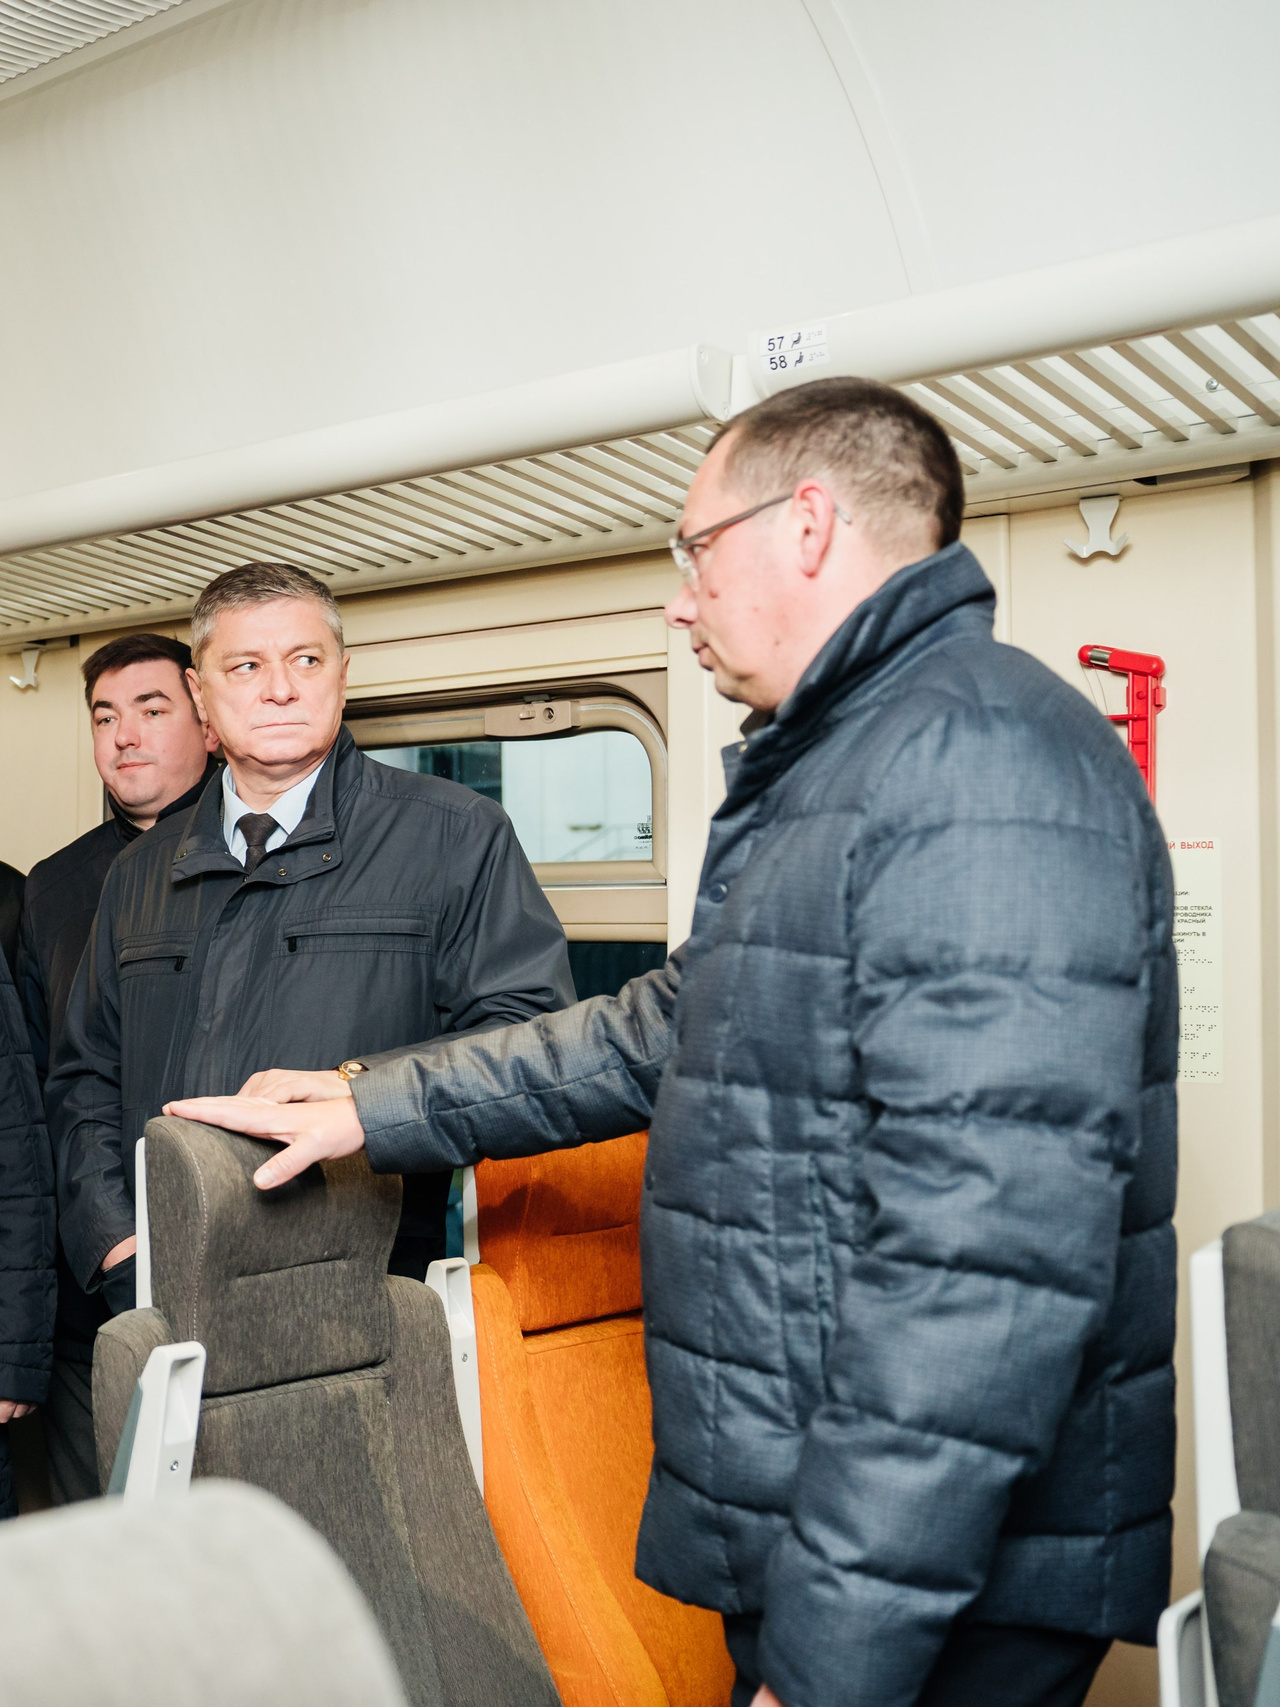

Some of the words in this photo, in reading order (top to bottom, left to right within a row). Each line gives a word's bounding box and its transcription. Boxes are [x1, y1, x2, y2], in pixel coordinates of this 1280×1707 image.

[767, 335, 785, 352] 57
[769, 355, 788, 371] 58
[1180, 840, 1214, 850] ВЫХОД
